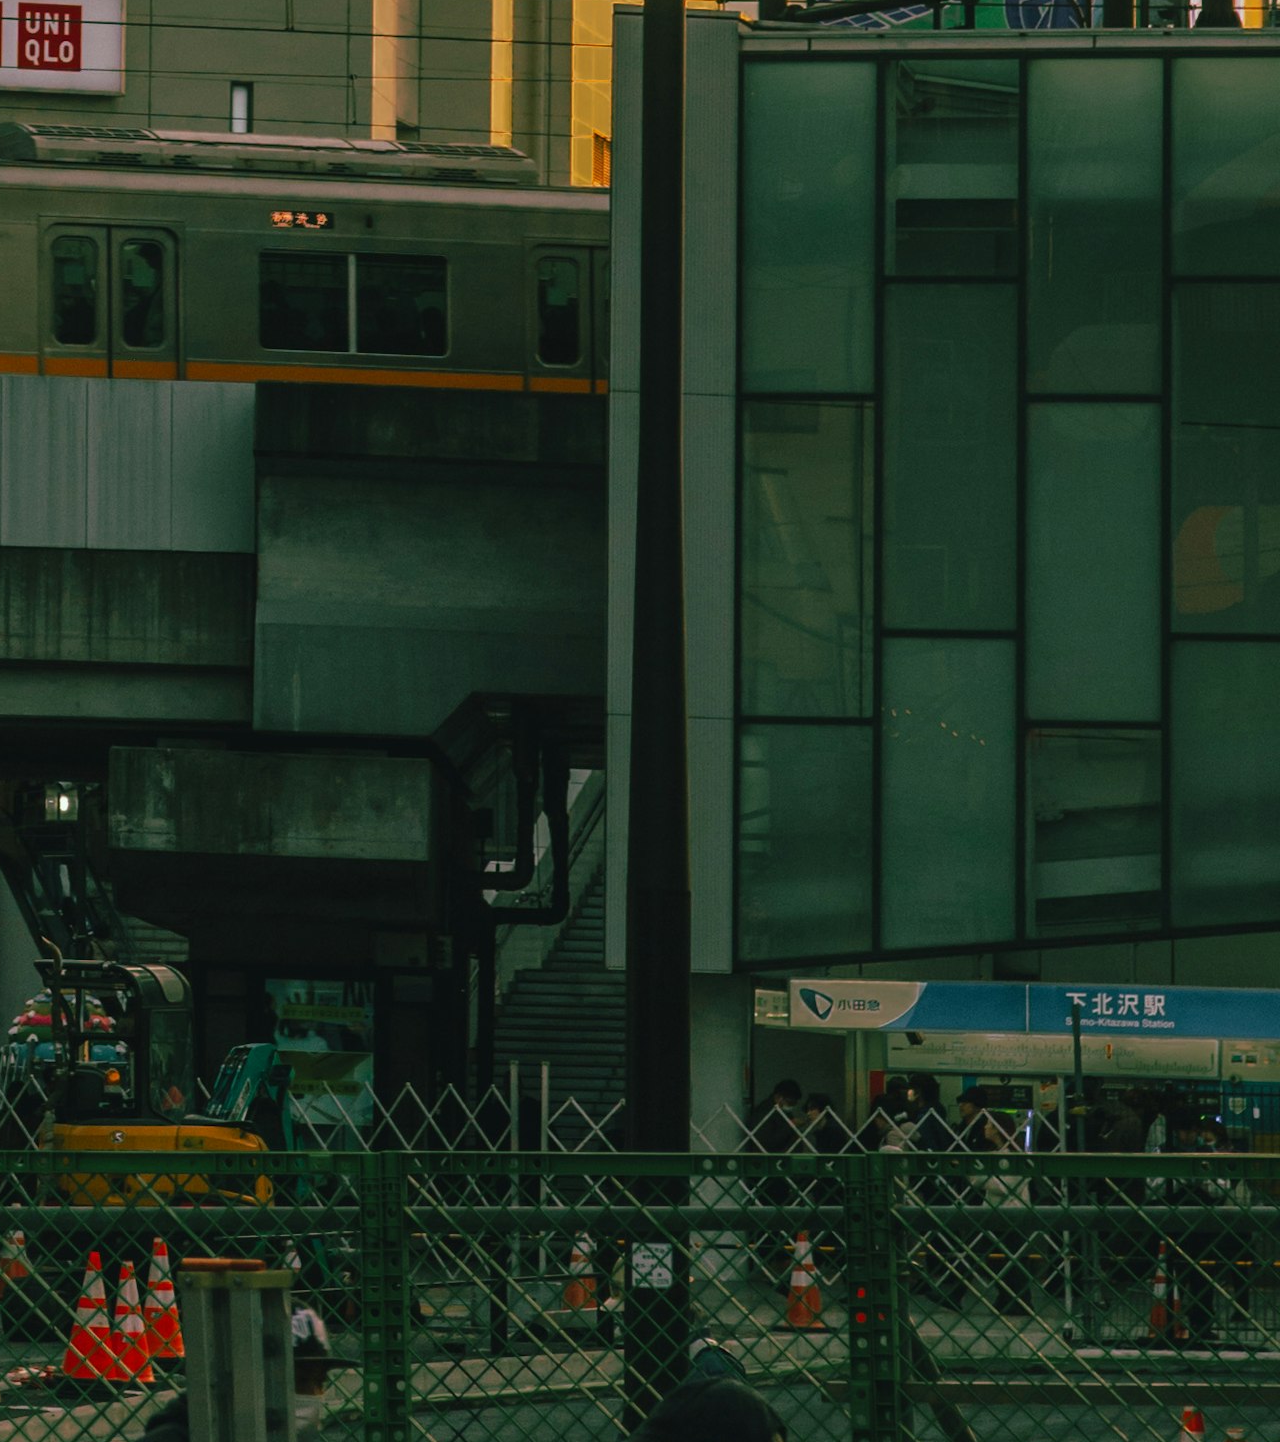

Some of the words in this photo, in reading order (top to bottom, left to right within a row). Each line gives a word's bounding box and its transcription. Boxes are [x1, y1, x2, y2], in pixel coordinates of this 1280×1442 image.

[838, 999, 880, 1012] 小田急
[1065, 992, 1166, 1016] 下北沢駅
[1065, 1017, 1140, 1028] Smo-Kitazawa
[1142, 1019, 1175, 1028] Station
